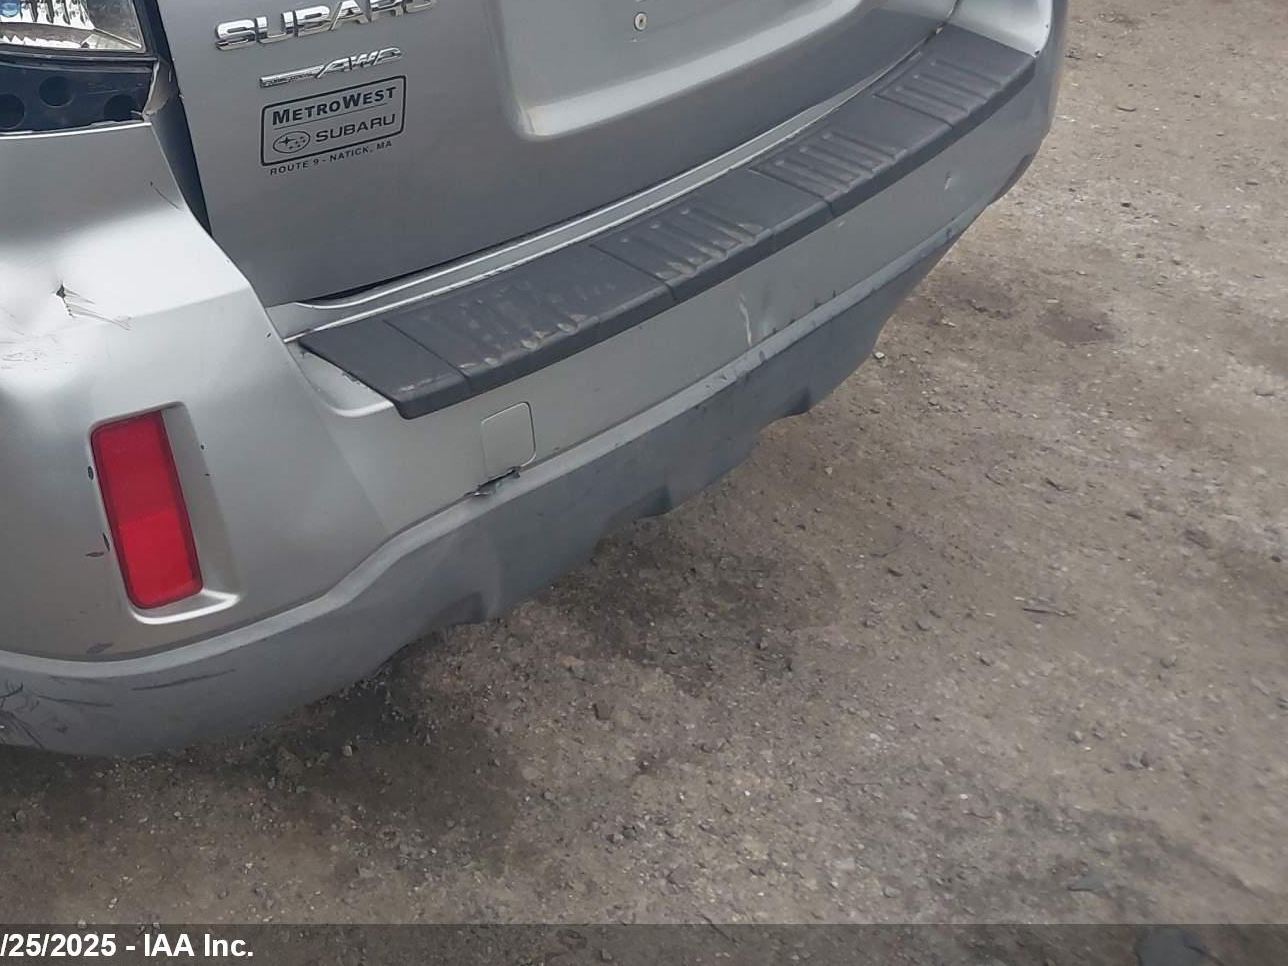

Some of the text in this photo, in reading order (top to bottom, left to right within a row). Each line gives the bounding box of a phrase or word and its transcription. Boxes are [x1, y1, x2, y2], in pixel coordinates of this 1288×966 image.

[316, 47, 403, 79] AWD
[315, 114, 396, 143] SUBARU
[270, 160, 310, 175] ROUTE
[313, 158, 320, 167] 9
[376, 140, 393, 151] MA
